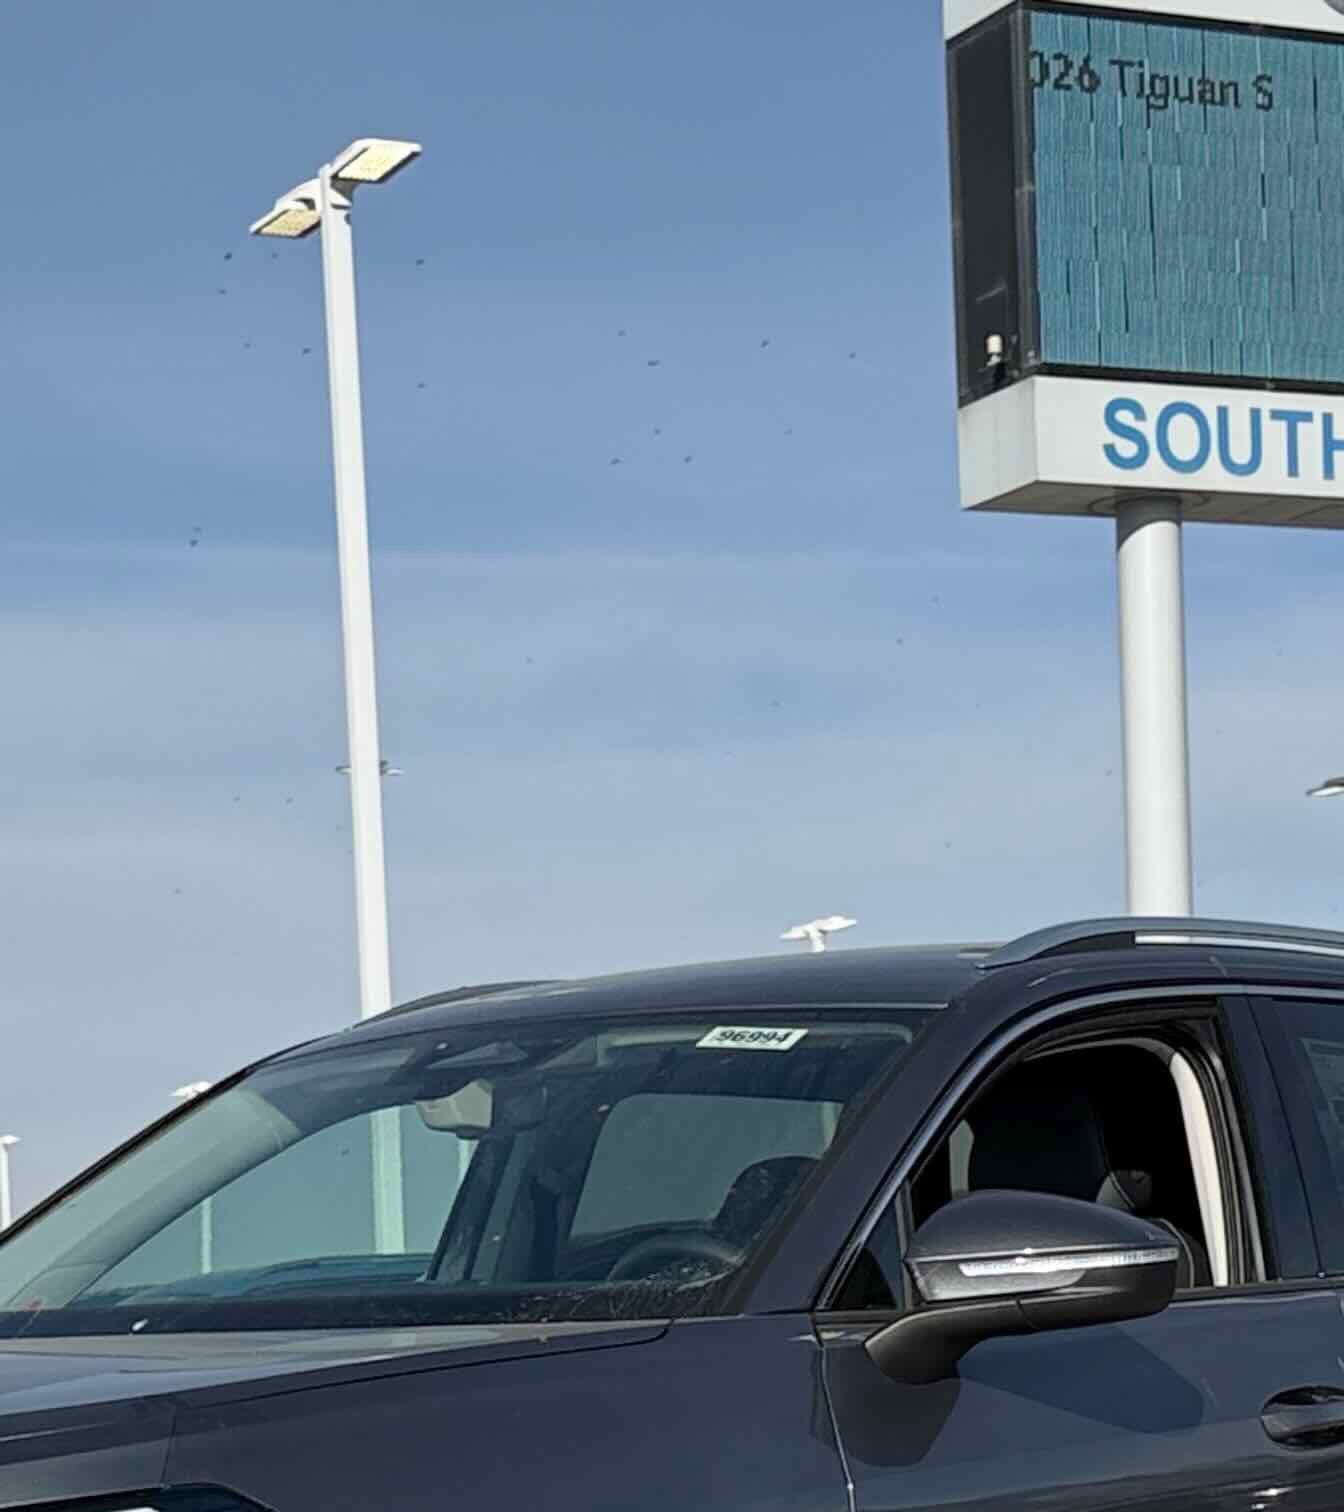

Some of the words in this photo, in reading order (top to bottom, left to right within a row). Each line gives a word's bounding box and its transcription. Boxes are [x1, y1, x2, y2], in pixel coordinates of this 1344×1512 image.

[1108, 58, 1241, 110] Tiguan
[1252, 72, 1273, 110] S
[718, 1029, 793, 1044] 96994
